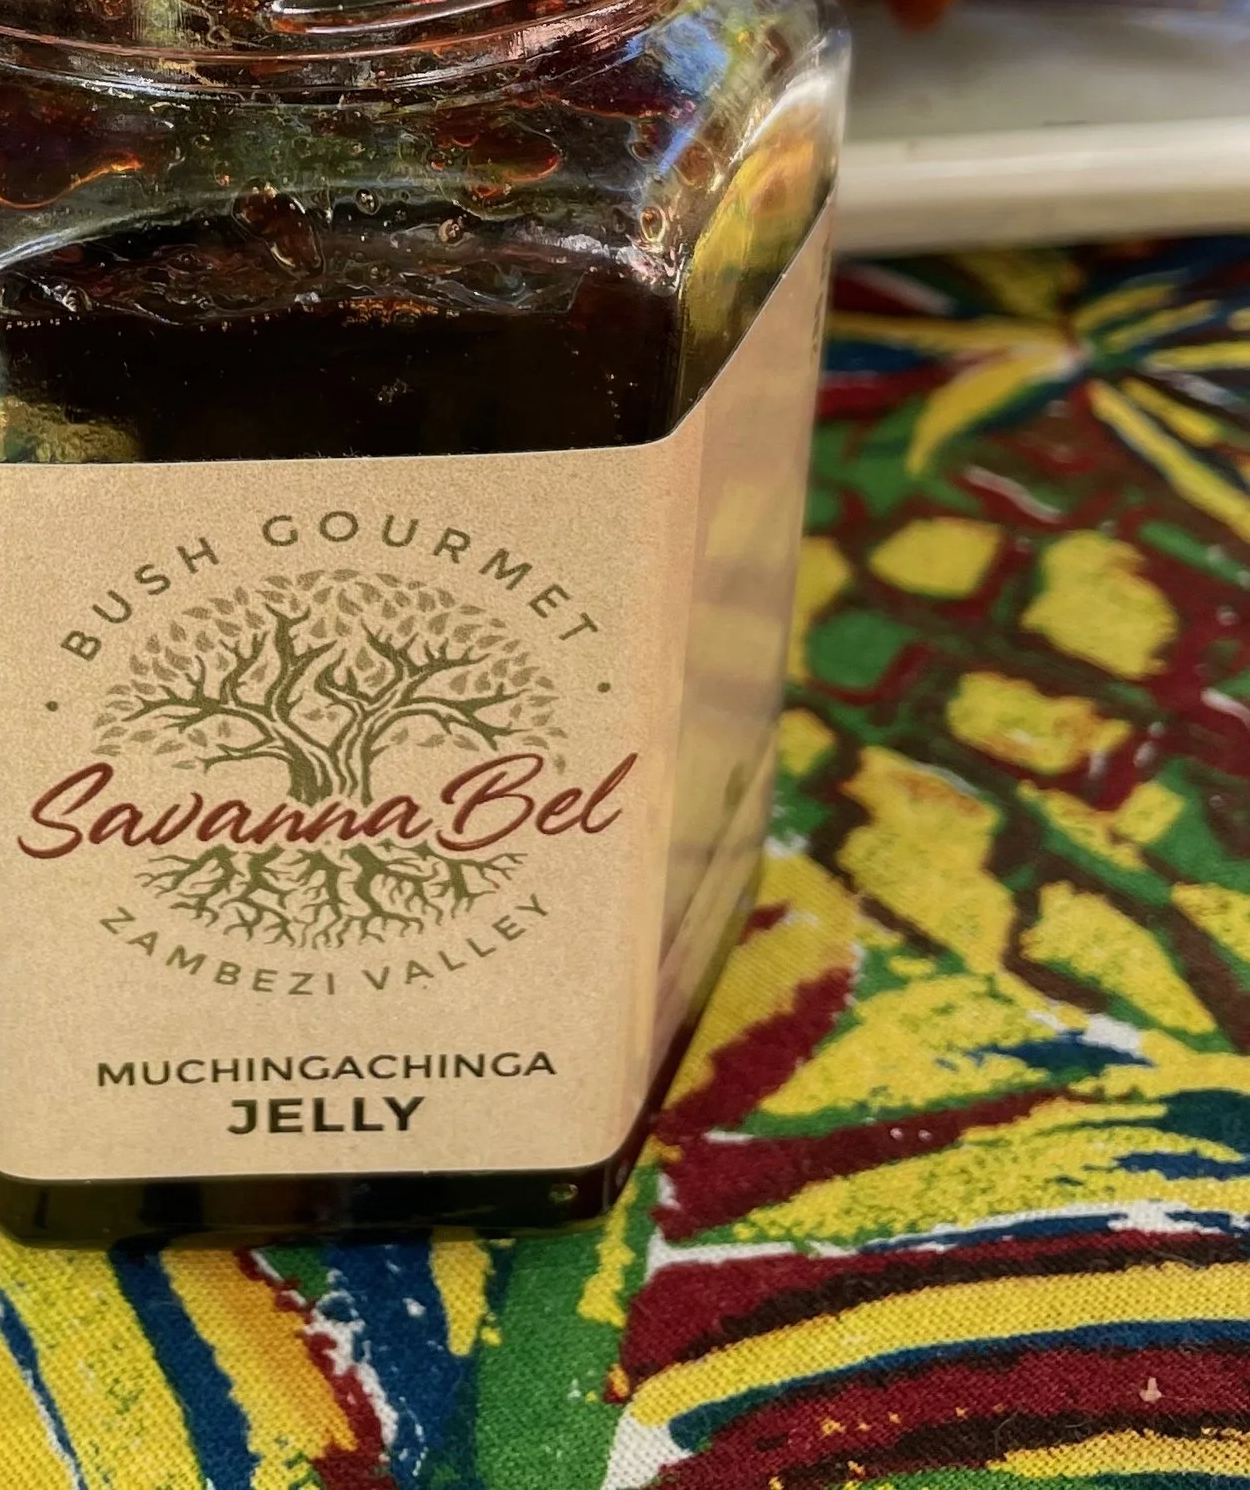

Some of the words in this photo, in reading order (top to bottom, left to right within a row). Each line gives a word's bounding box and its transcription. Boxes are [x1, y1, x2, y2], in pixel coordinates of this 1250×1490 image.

[60, 536, 220, 662] BUSH
[261, 510, 599, 641] GOURMET
[100, 907, 337, 997] ZAMBEZI
[362, 896, 550, 993] VALLEY
[96, 1051, 558, 1088] MUCHINGACHINGA
[227, 1096, 426, 1136] JELLY
